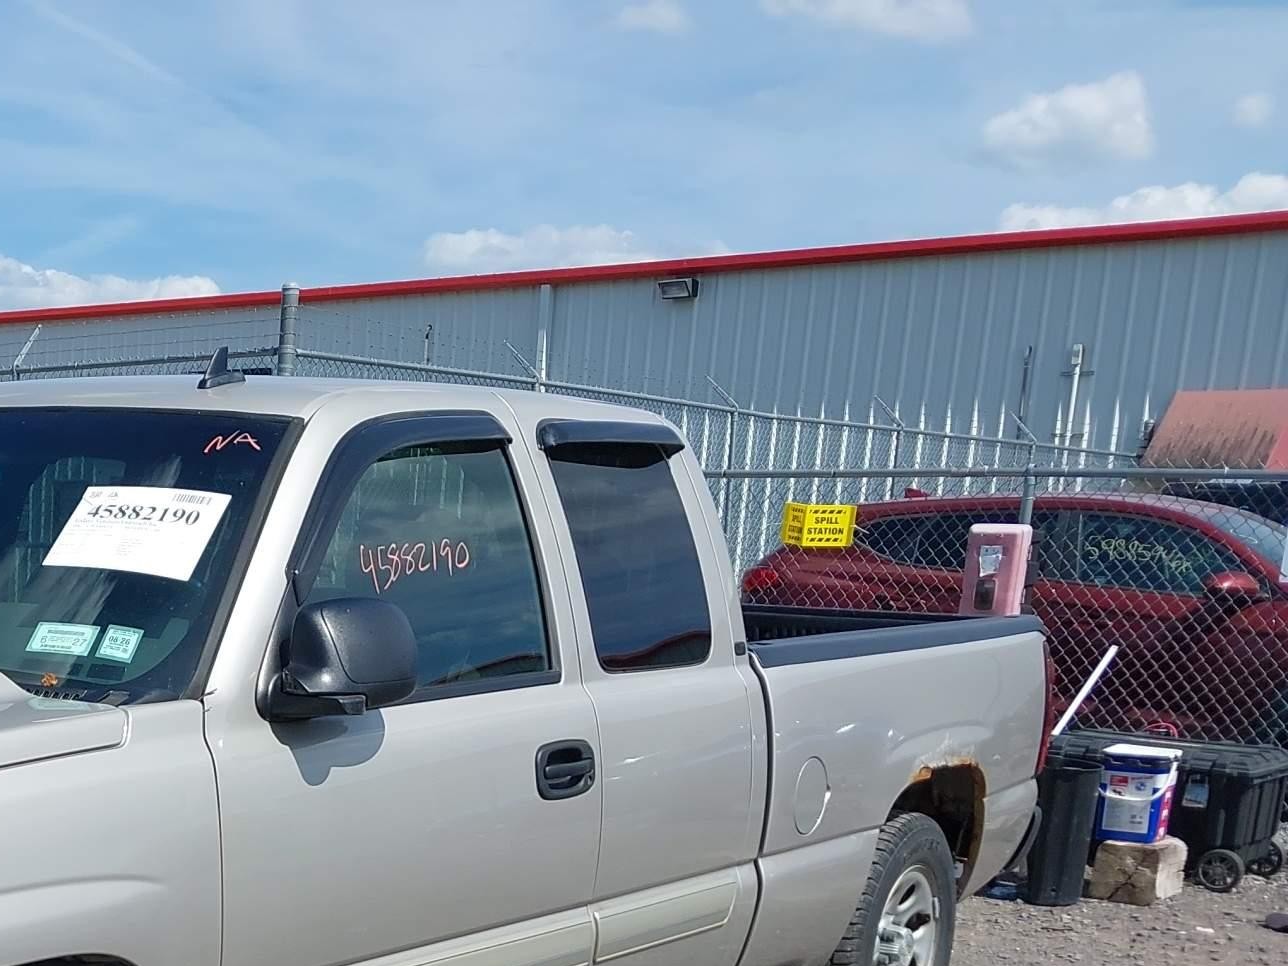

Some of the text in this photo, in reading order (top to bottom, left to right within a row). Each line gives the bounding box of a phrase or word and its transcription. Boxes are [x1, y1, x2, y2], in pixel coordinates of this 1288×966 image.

[204, 429, 262, 454] NA
[87, 503, 201, 526] 45882190
[814, 516, 840, 525] SPILL
[806, 527, 844, 536] STATION
[359, 538, 470, 594] 45882190
